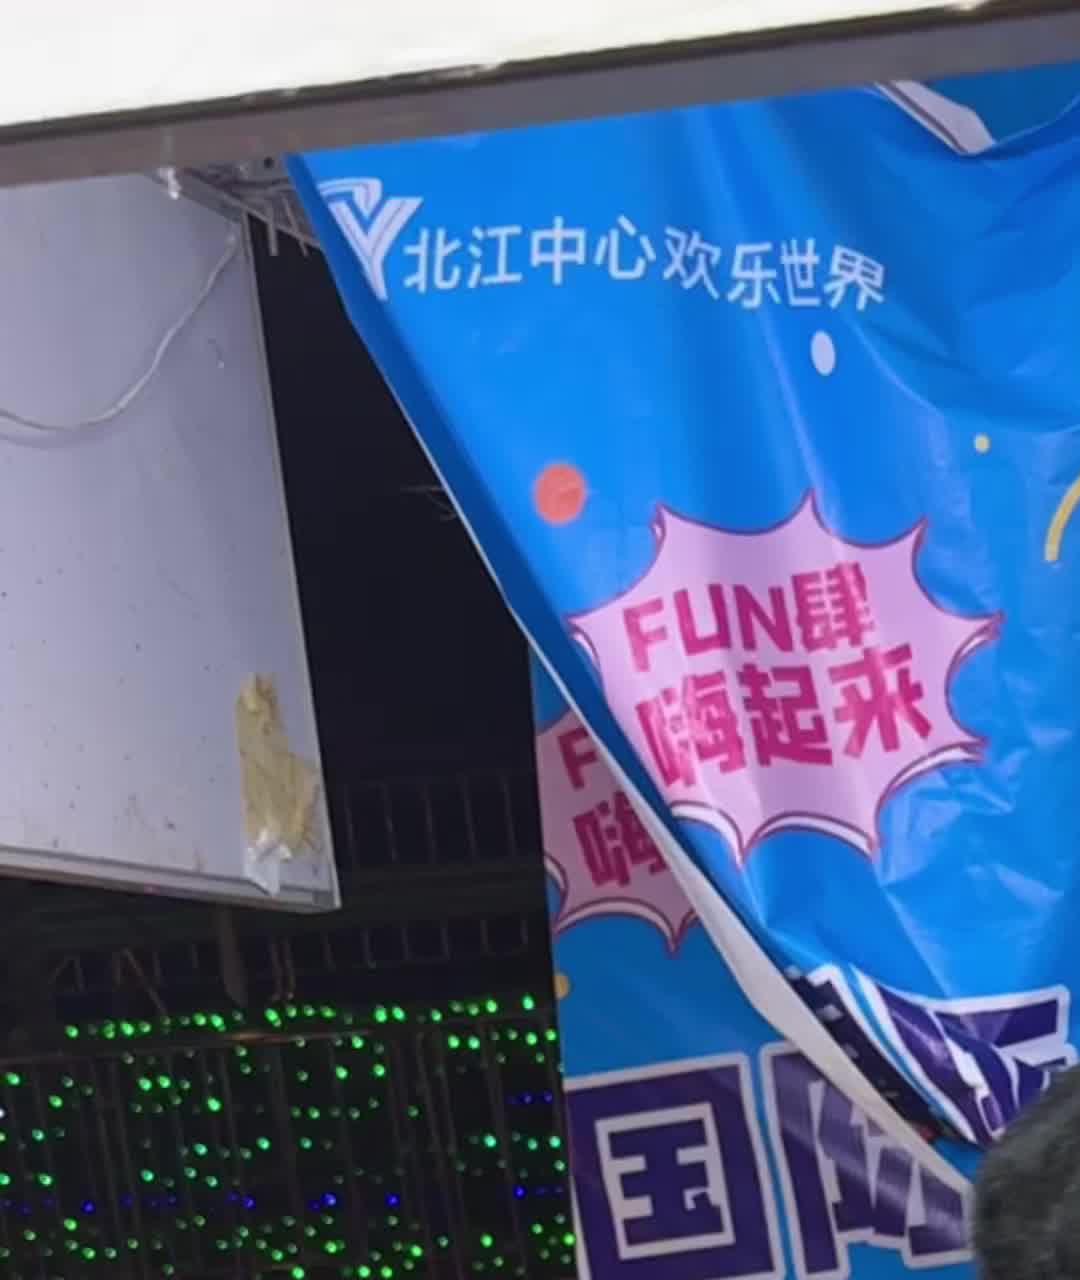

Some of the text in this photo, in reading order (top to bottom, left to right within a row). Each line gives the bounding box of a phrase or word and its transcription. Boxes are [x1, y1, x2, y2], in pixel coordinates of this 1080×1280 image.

[402, 215, 886, 311] 北江中心欢乐世界
[622, 560, 876, 672] FUN肆
[634, 643, 932, 788] 嗨起来
